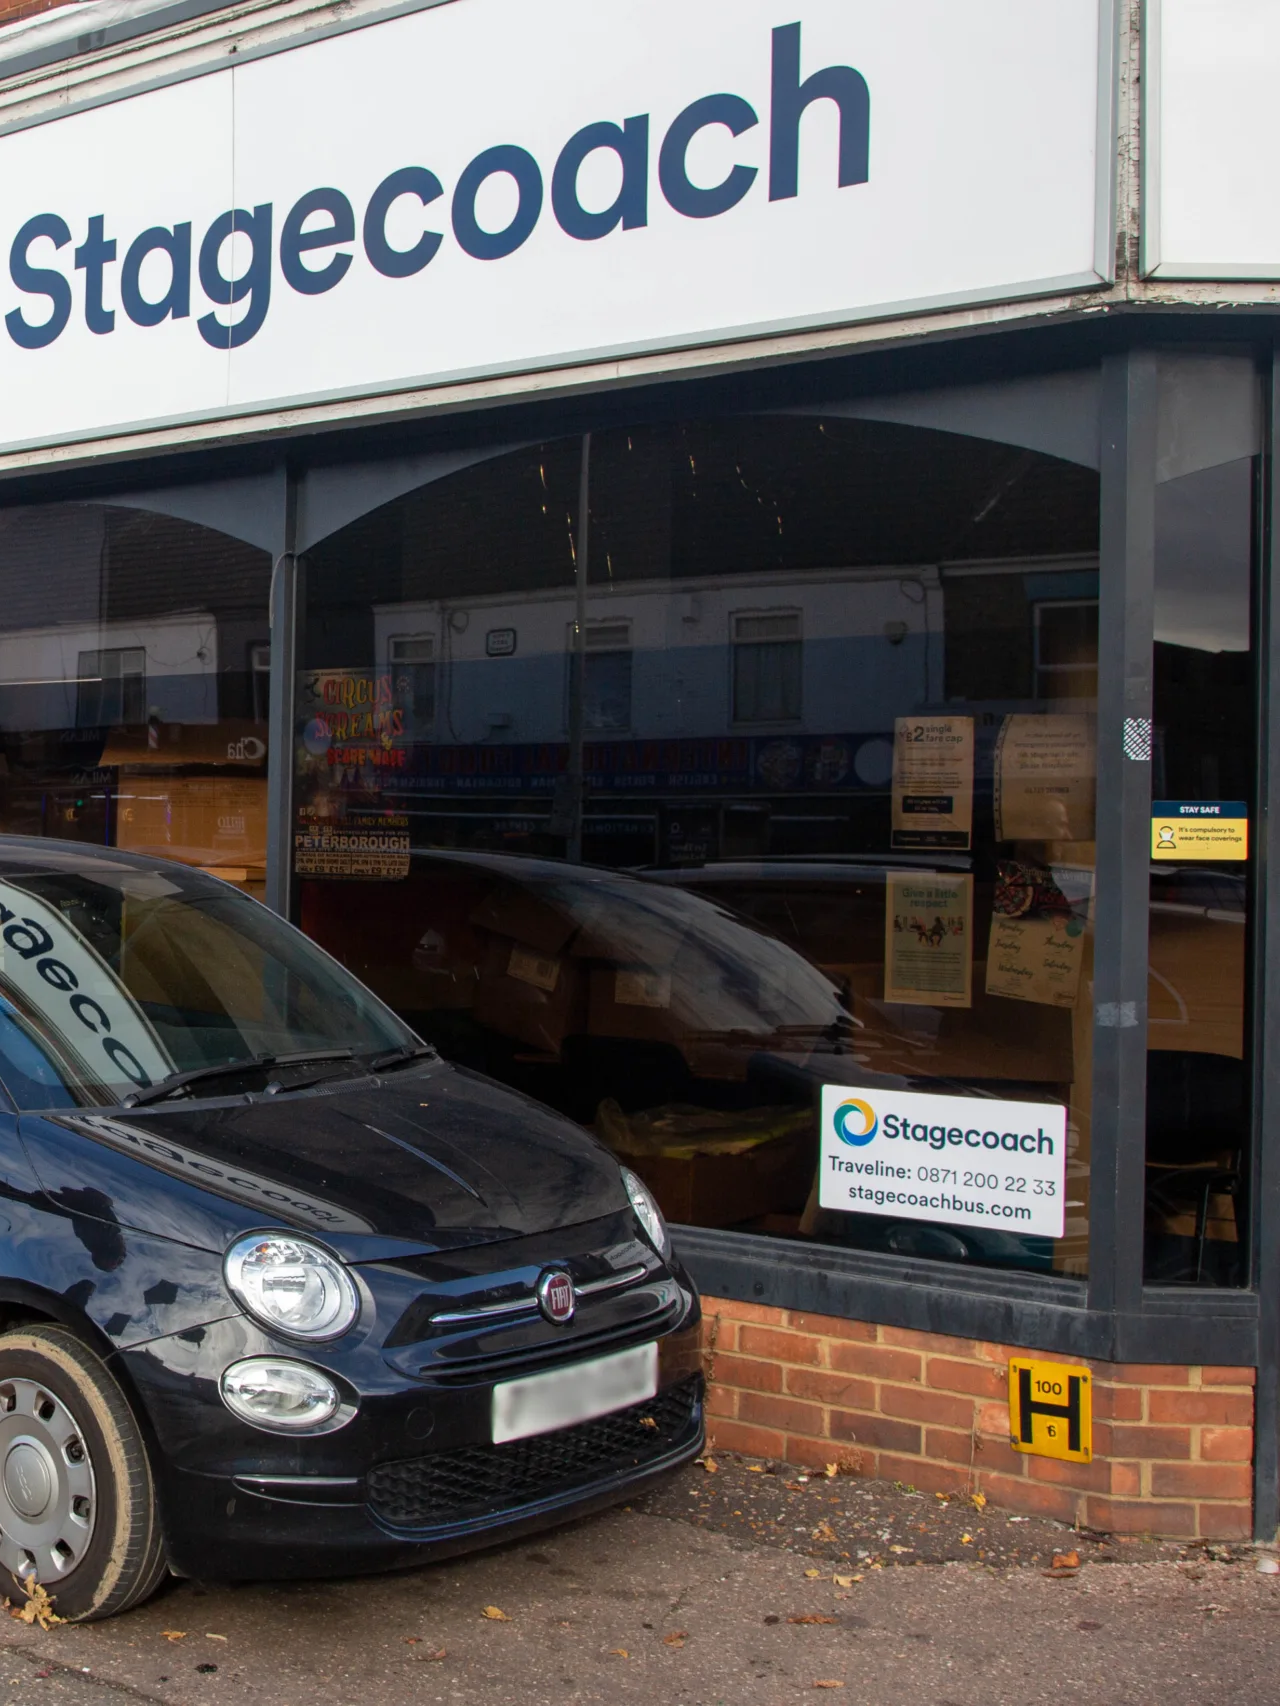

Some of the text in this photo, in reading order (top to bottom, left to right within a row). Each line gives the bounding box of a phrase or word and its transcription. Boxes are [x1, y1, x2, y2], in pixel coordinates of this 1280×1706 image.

[5, 21, 870, 350] Stagecoach
[323, 675, 393, 709] CIRCUS
[315, 708, 405, 741] SCREAMS
[905, 724, 953, 743] £2 single
[926, 734, 964, 745] fare cap
[327, 747, 367, 767] SCARE
[1179, 805, 1220, 814] STAY SAFE
[1178, 826, 1188, 834] It's
[1189, 826, 1226, 837] compulsory
[1196, 834, 1213, 842] face
[1214, 835, 1243, 844] coverings
[295, 835, 410, 850] PETERBOROUGH
[902, 887, 959, 899] Give a little
[910, 899, 949, 908] respect
[997, 963, 1034, 979] Wednesday
[1042, 958, 1073, 974] Saturday
[882, 1113, 1055, 1156] Stagecoach
[827, 1154, 1056, 1197] Traveline: 0871 200 22 33
[848, 1185, 1032, 1221] stagecoachbus.com
[551, 1284, 571, 1311] FIAT
[1035, 1380, 1063, 1396] 100
[1018, 1368, 1081, 1453] H
